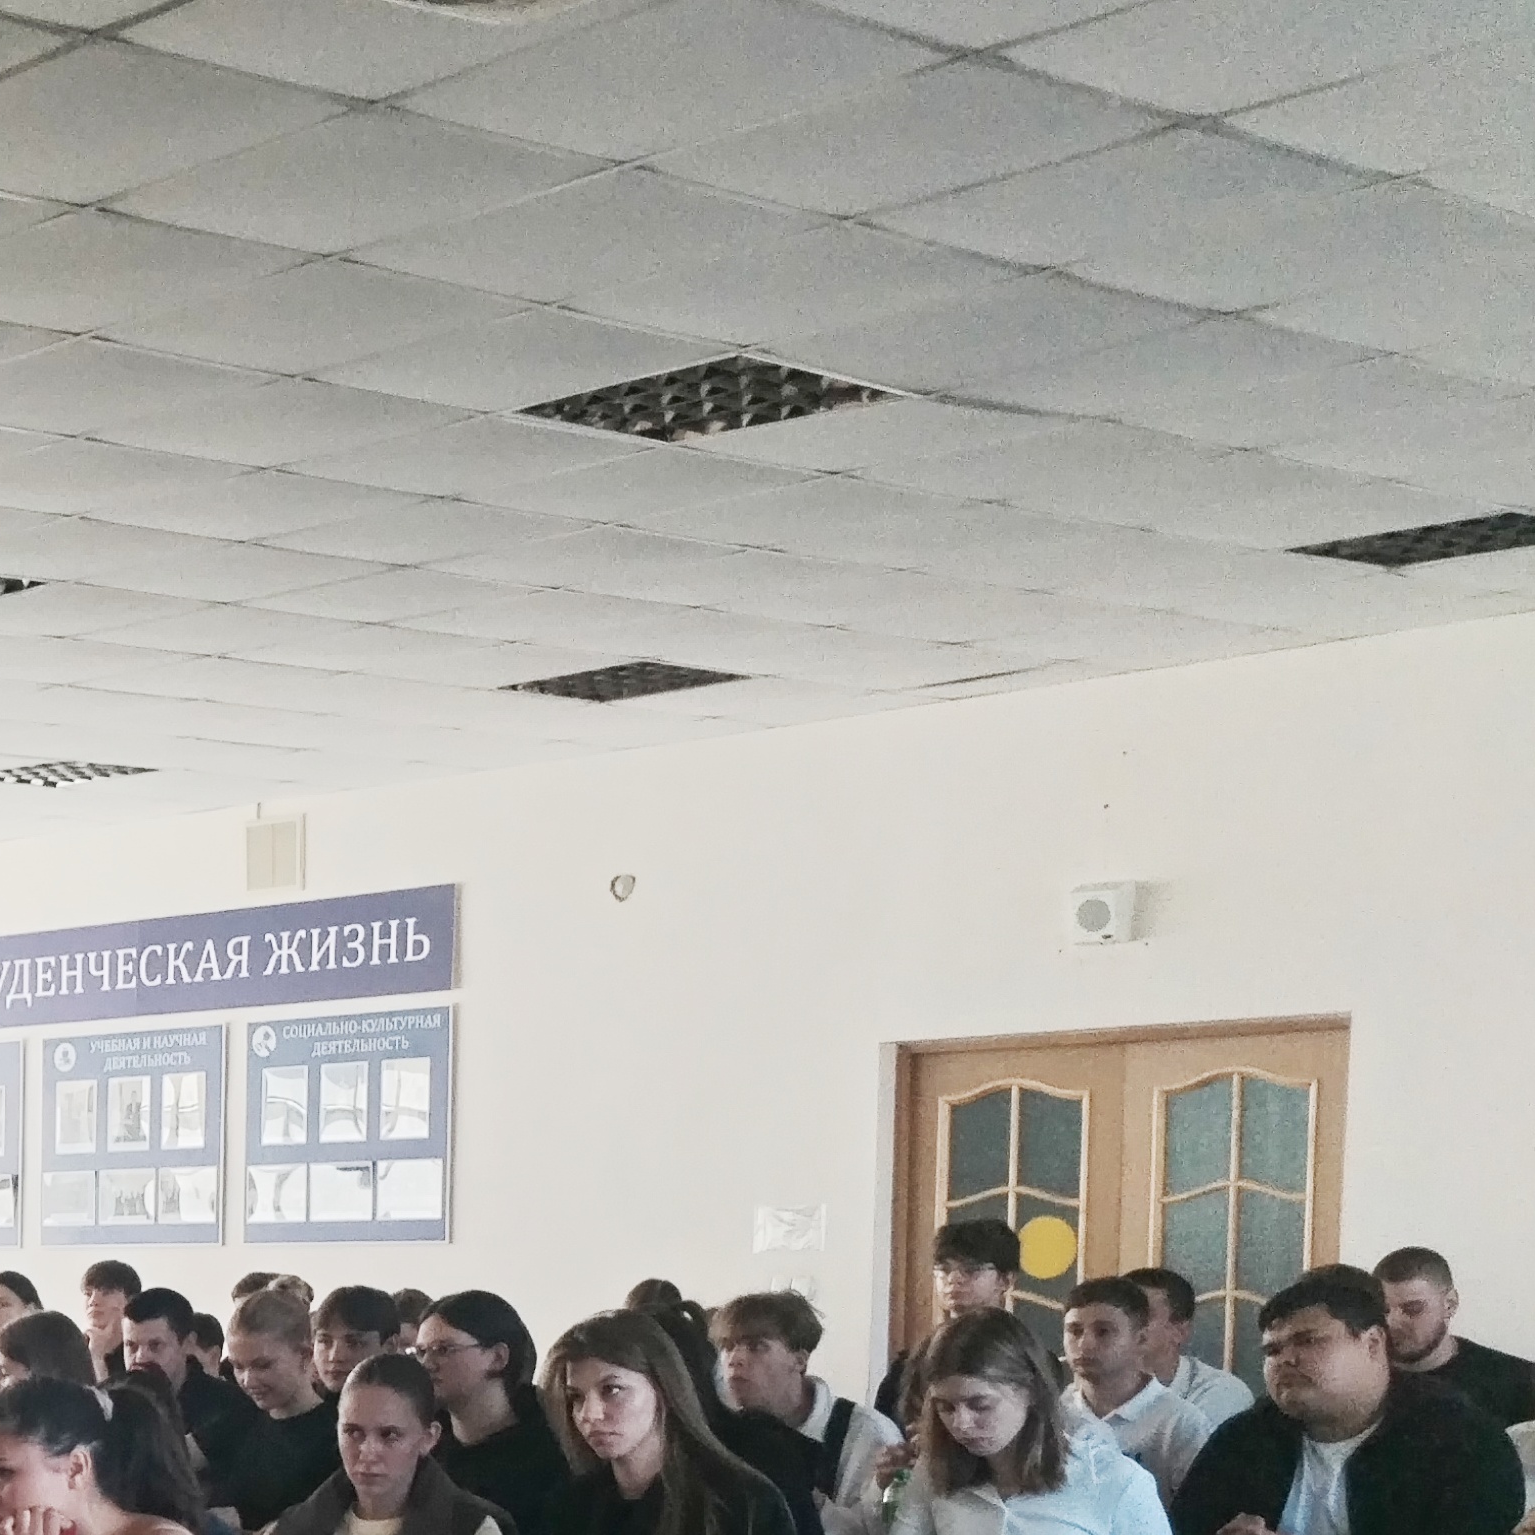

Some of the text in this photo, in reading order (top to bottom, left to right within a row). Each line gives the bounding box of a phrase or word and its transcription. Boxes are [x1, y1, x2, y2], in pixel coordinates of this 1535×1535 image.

[262, 917, 432, 977] ЖИЗНЬ
[282, 1013, 441, 1039] СОЦИАЛЬНО-КУЛЬТУРНАЯ
[89, 1031, 208, 1054] УЧЕБНАЯ И НАУЧНАЯ
[310, 1035, 410, 1058] ДЕЯТЕЛЬНОСТЬ
[103, 1051, 191, 1073] ДЕЯТЕЛЬНОСТЬ
